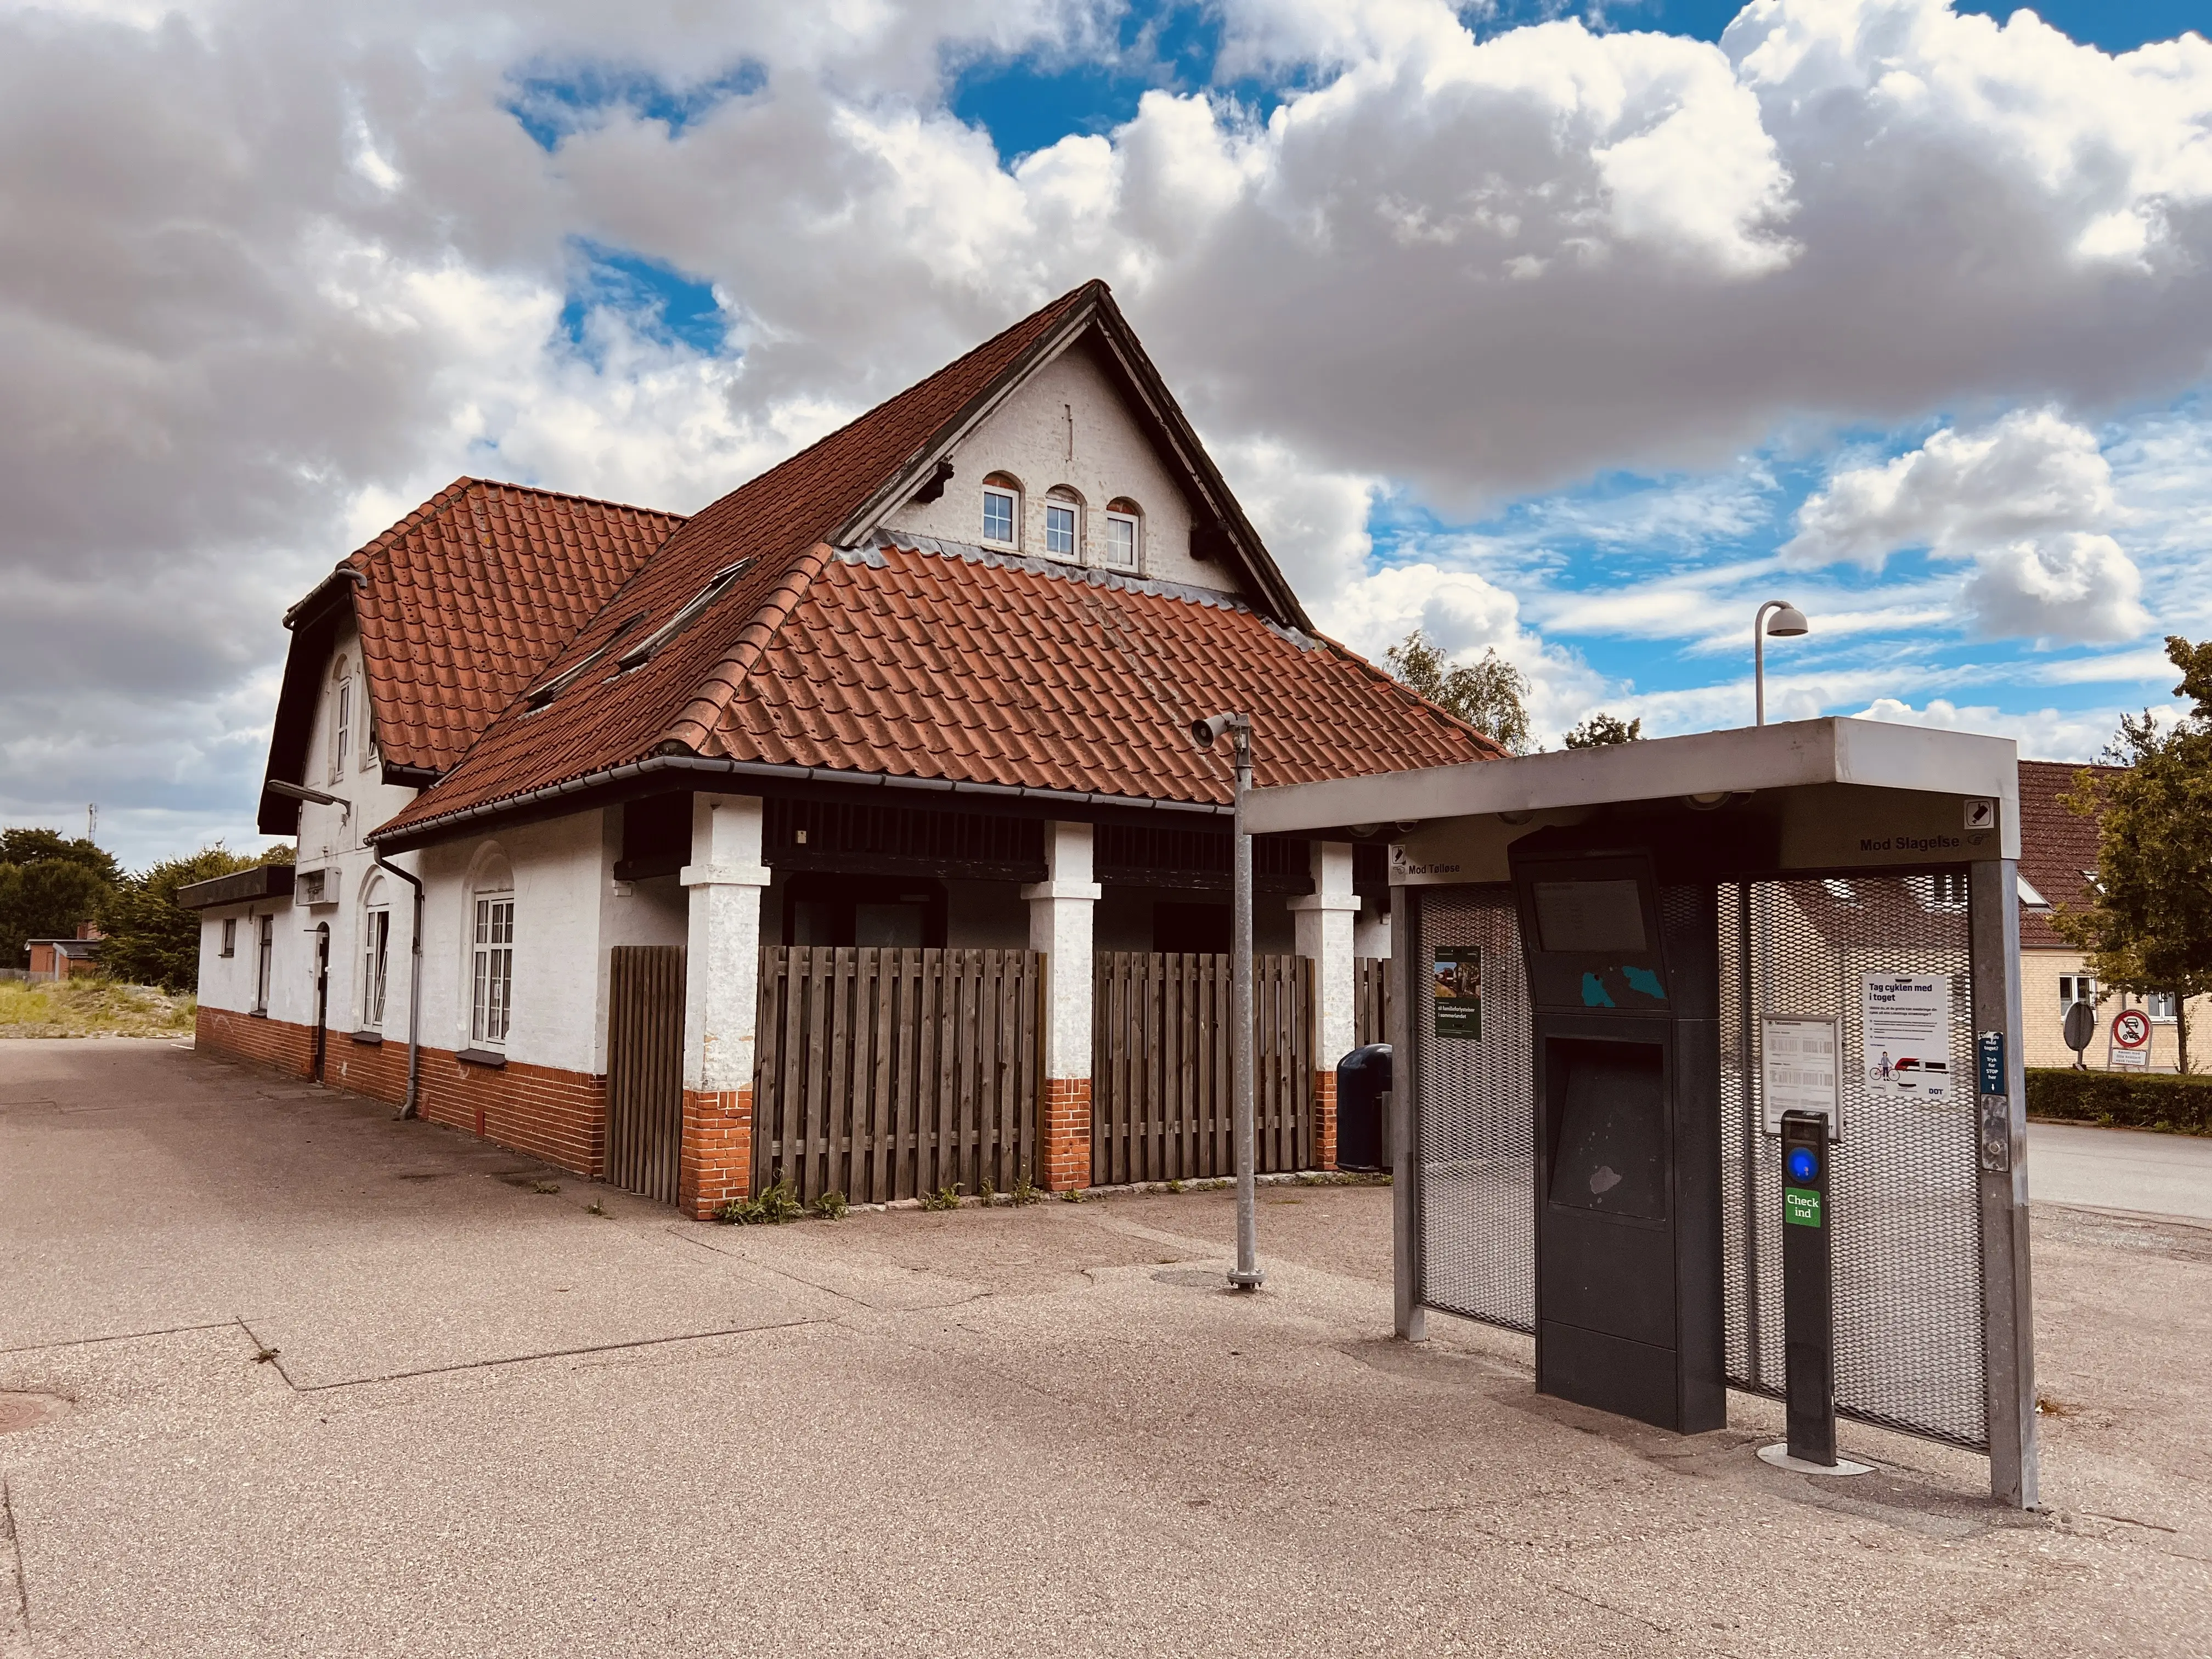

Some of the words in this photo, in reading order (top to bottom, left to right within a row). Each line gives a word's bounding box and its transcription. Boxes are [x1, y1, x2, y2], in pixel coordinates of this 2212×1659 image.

[1860, 838, 1891, 851] Mod
[1895, 835, 1960, 851] Slagelse
[1409, 865, 1426, 875] Mod
[1429, 864, 1460, 873] Tølløse
[1869, 984, 1883, 992] Tag
[1885, 984, 1912, 992] cyklen
[1874, 994, 1895, 1002] toget
[1787, 1194, 1819, 1208] Check
[1795, 1206, 1811, 1218] ind
